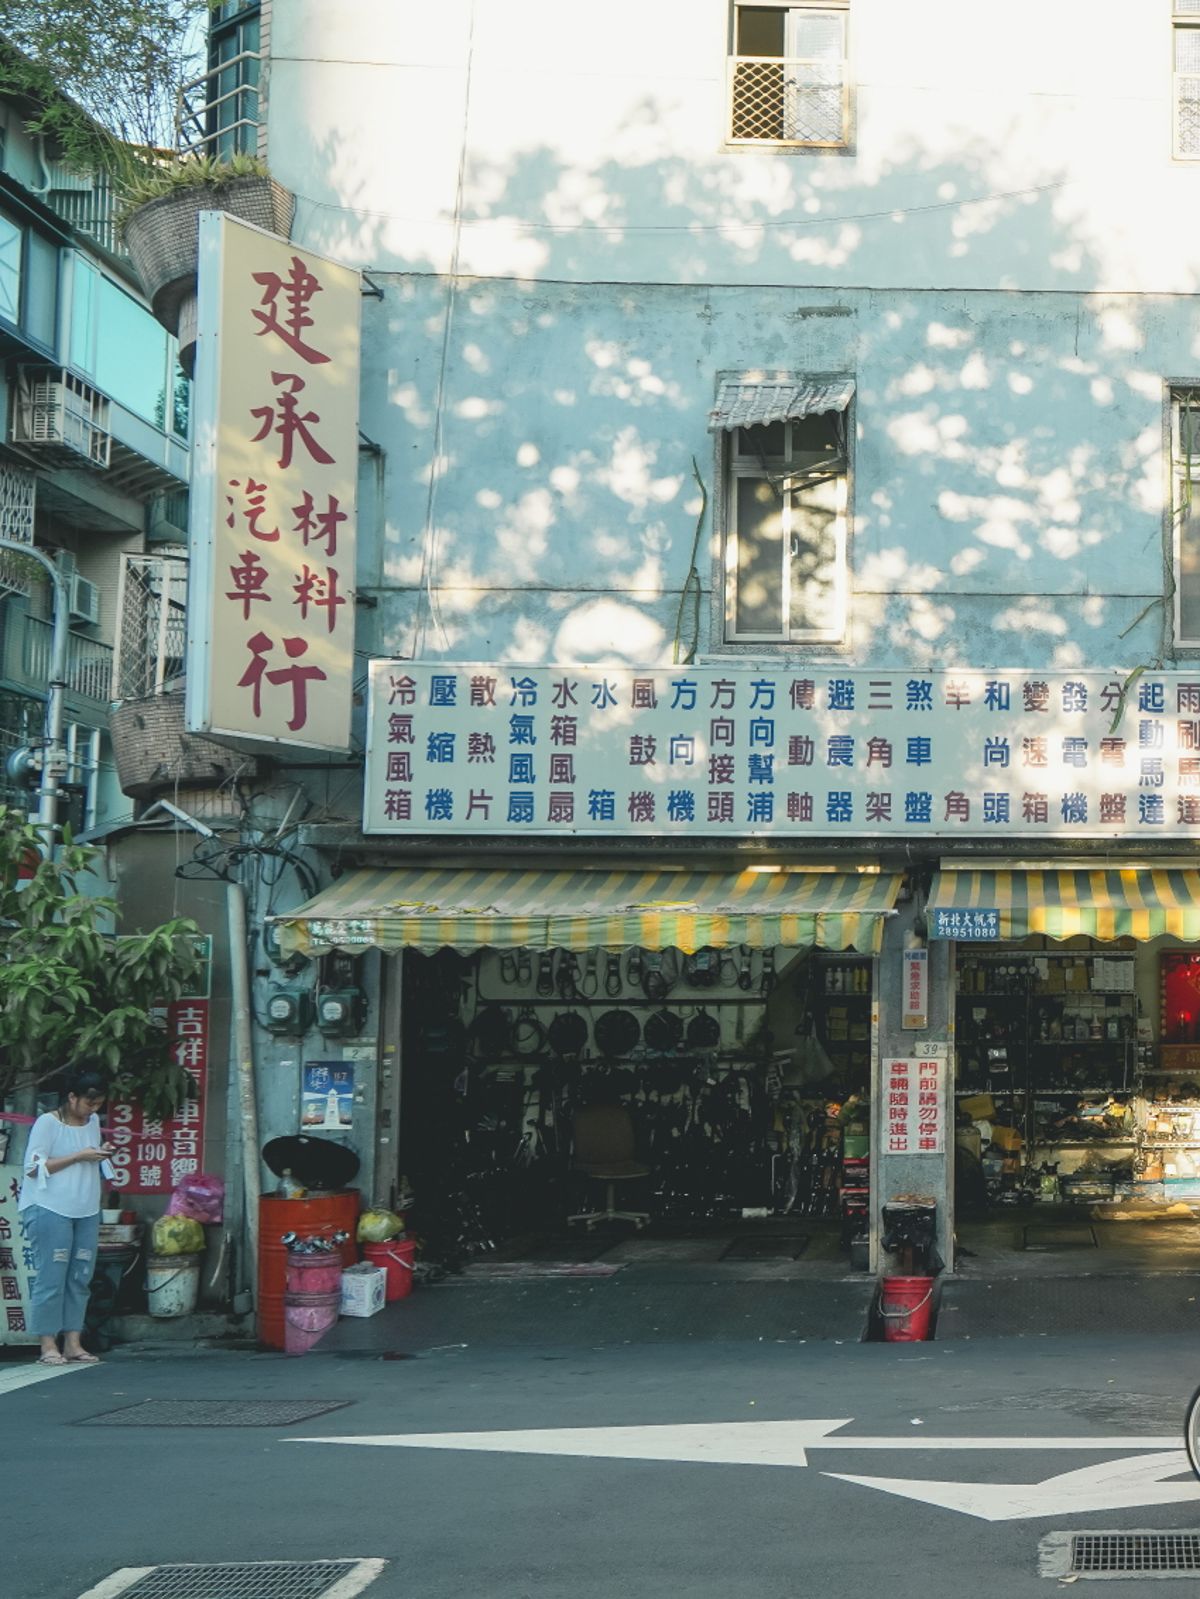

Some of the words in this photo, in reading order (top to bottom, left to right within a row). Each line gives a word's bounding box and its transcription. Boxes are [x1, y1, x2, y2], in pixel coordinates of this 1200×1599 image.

[250, 257, 336, 469] 建承
[236, 630, 328, 732] 行
[384, 675, 417, 821] 冷氣風箱
[425, 675, 457, 821] 壓縮機
[465, 676, 497, 821] 散熱片
[507, 676, 538, 823] 冷氣風扇
[547, 677, 579, 823] 水箱風扇
[587, 678, 618, 822] 水箱
[628, 678, 658, 823] 風鼓機
[667, 678, 697, 823] 方向機
[706, 678, 737, 824] 方向接頭
[746, 678, 776, 824] 方向幫浦
[786, 678, 816, 824] 傳動軸
[825, 679, 855, 824] 避震器
[865, 679, 893, 824] 三角架
[904, 679, 934, 824] 煞車盤
[943, 679, 971, 824] 羊角
[983, 680, 1012, 824] 和尚頭
[1021, 680, 1050, 824] 變速箱
[1060, 681, 1089, 825] 發電機
[1099, 681, 1128, 825] 分電盤
[1137, 682, 1165, 826] 起動馬達
[938, 926, 996, 938] 28951080
[171, 1007, 204, 1187] 吉祥車音響
[889, 1062, 909, 1151] 車輛隨時進出
[918, 1062, 938, 1150] 門前請勿停車
